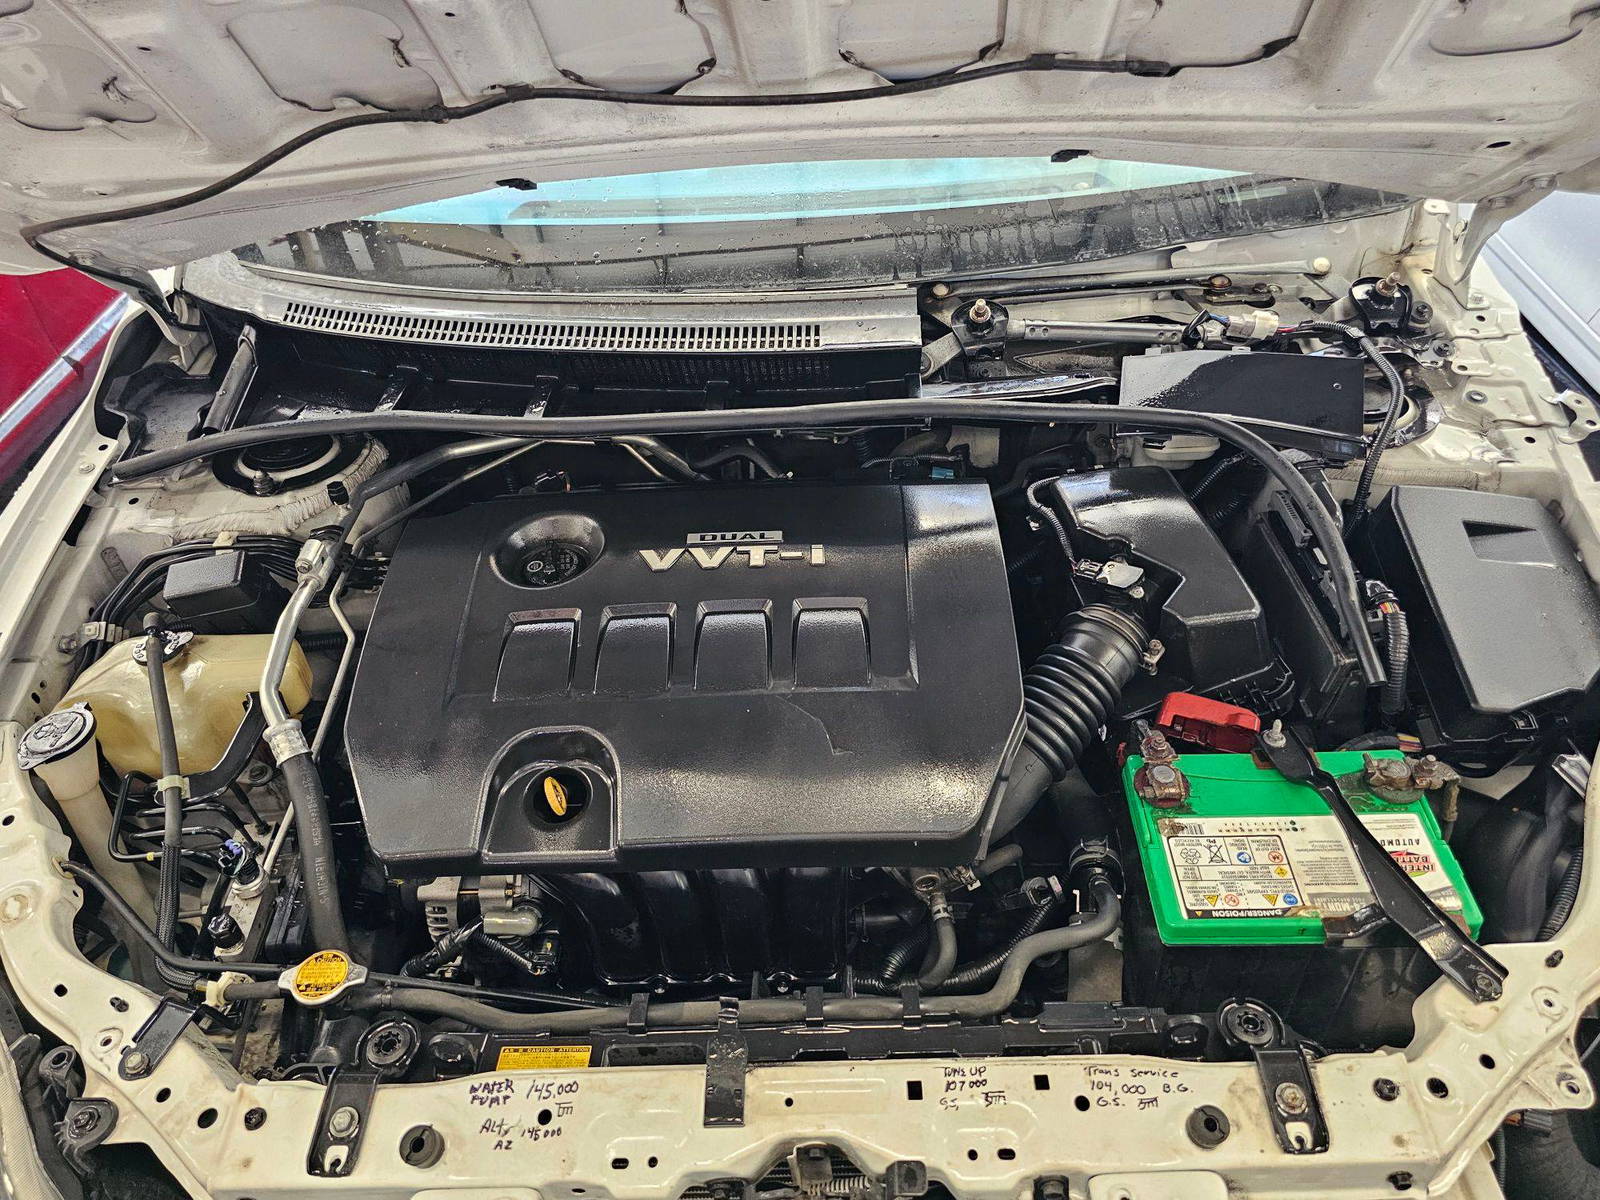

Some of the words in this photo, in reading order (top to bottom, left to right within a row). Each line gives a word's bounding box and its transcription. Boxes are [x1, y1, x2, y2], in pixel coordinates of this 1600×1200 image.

[700, 532, 774, 541] DUAL
[1380, 838, 1420, 847] AUTOMO
[1212, 909, 1283, 918] DANGER/POISON
[969, 1066, 986, 1077] UP
[469, 1078, 514, 1095] WATER
[470, 1094, 512, 1109] PUMP
[493, 1140, 513, 1151] AZ
